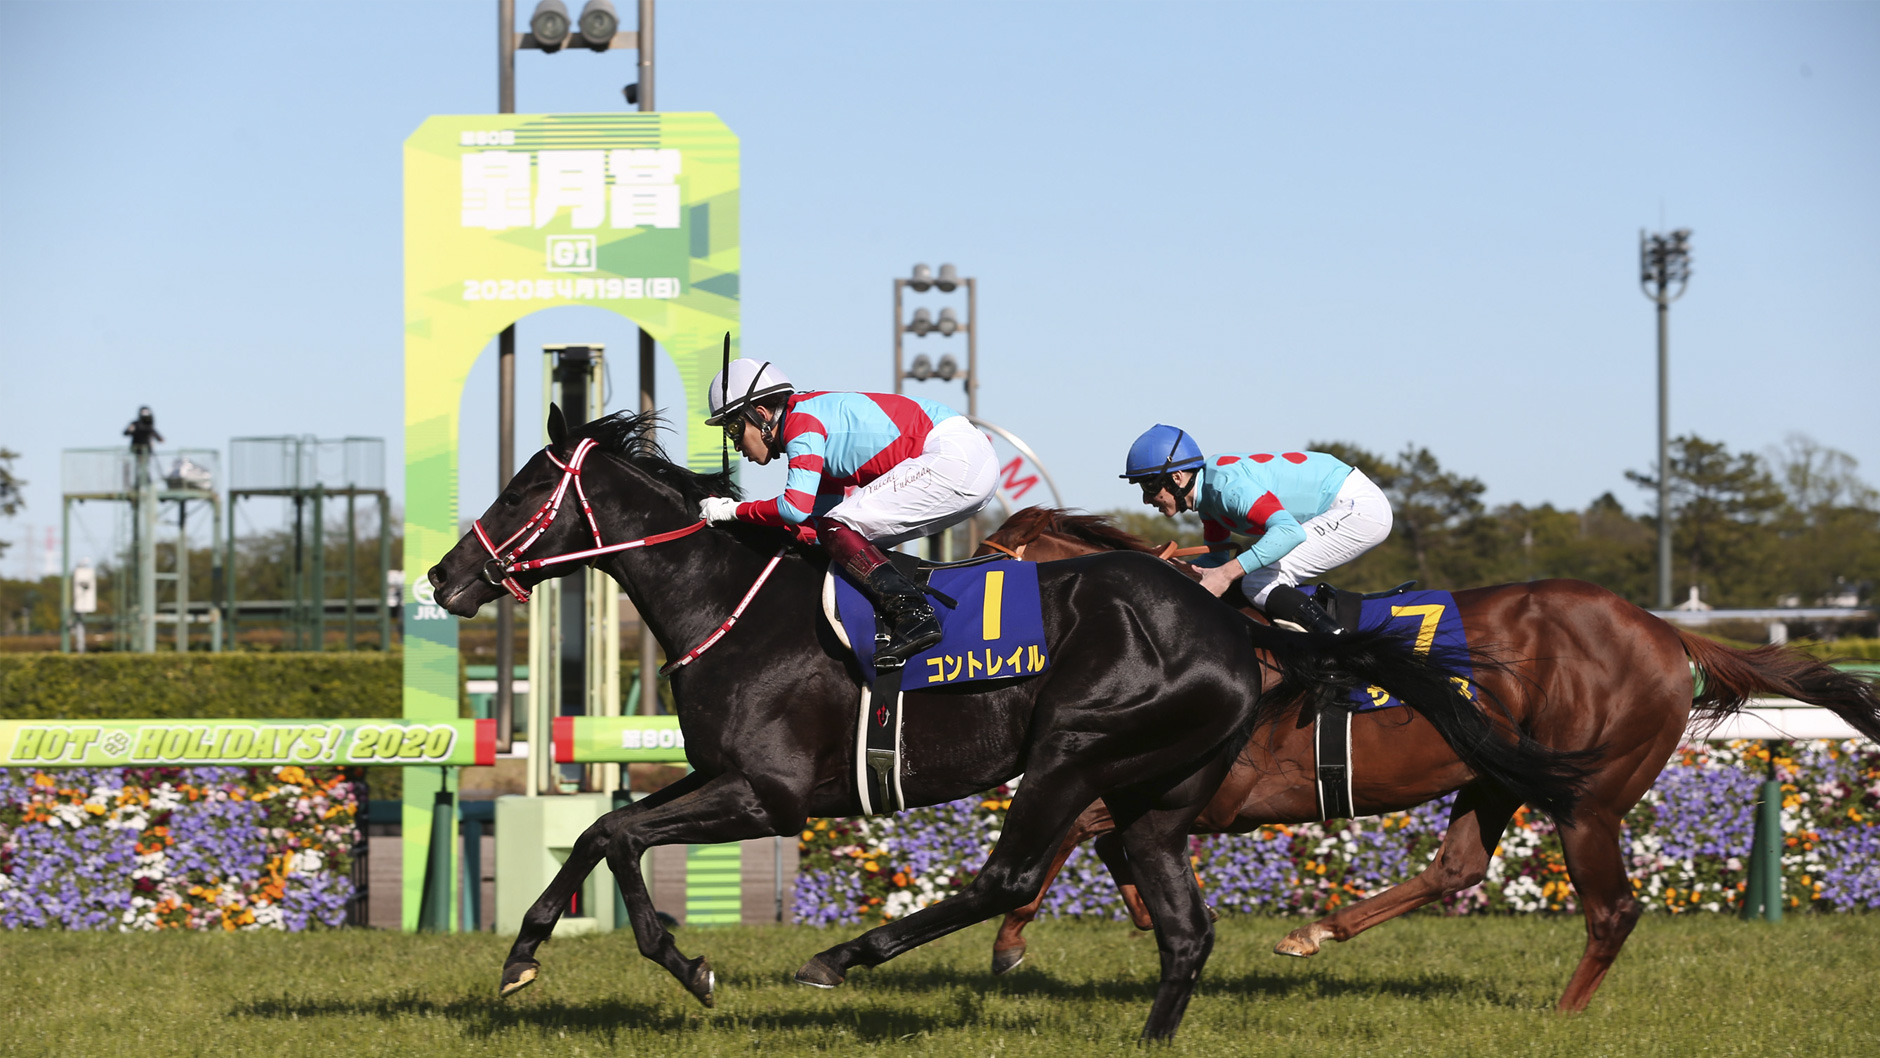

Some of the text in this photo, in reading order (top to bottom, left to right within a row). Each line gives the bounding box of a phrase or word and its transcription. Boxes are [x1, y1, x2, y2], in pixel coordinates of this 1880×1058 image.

[460, 149, 682, 230] 皐月賞
[413, 605, 449, 621] JRA
[982, 570, 1005, 641] 1
[1391, 603, 1446, 658] 7
[926, 644, 1046, 683] コントレイル
[10, 725, 456, 762] HOT HOLIDAYS! 2020
